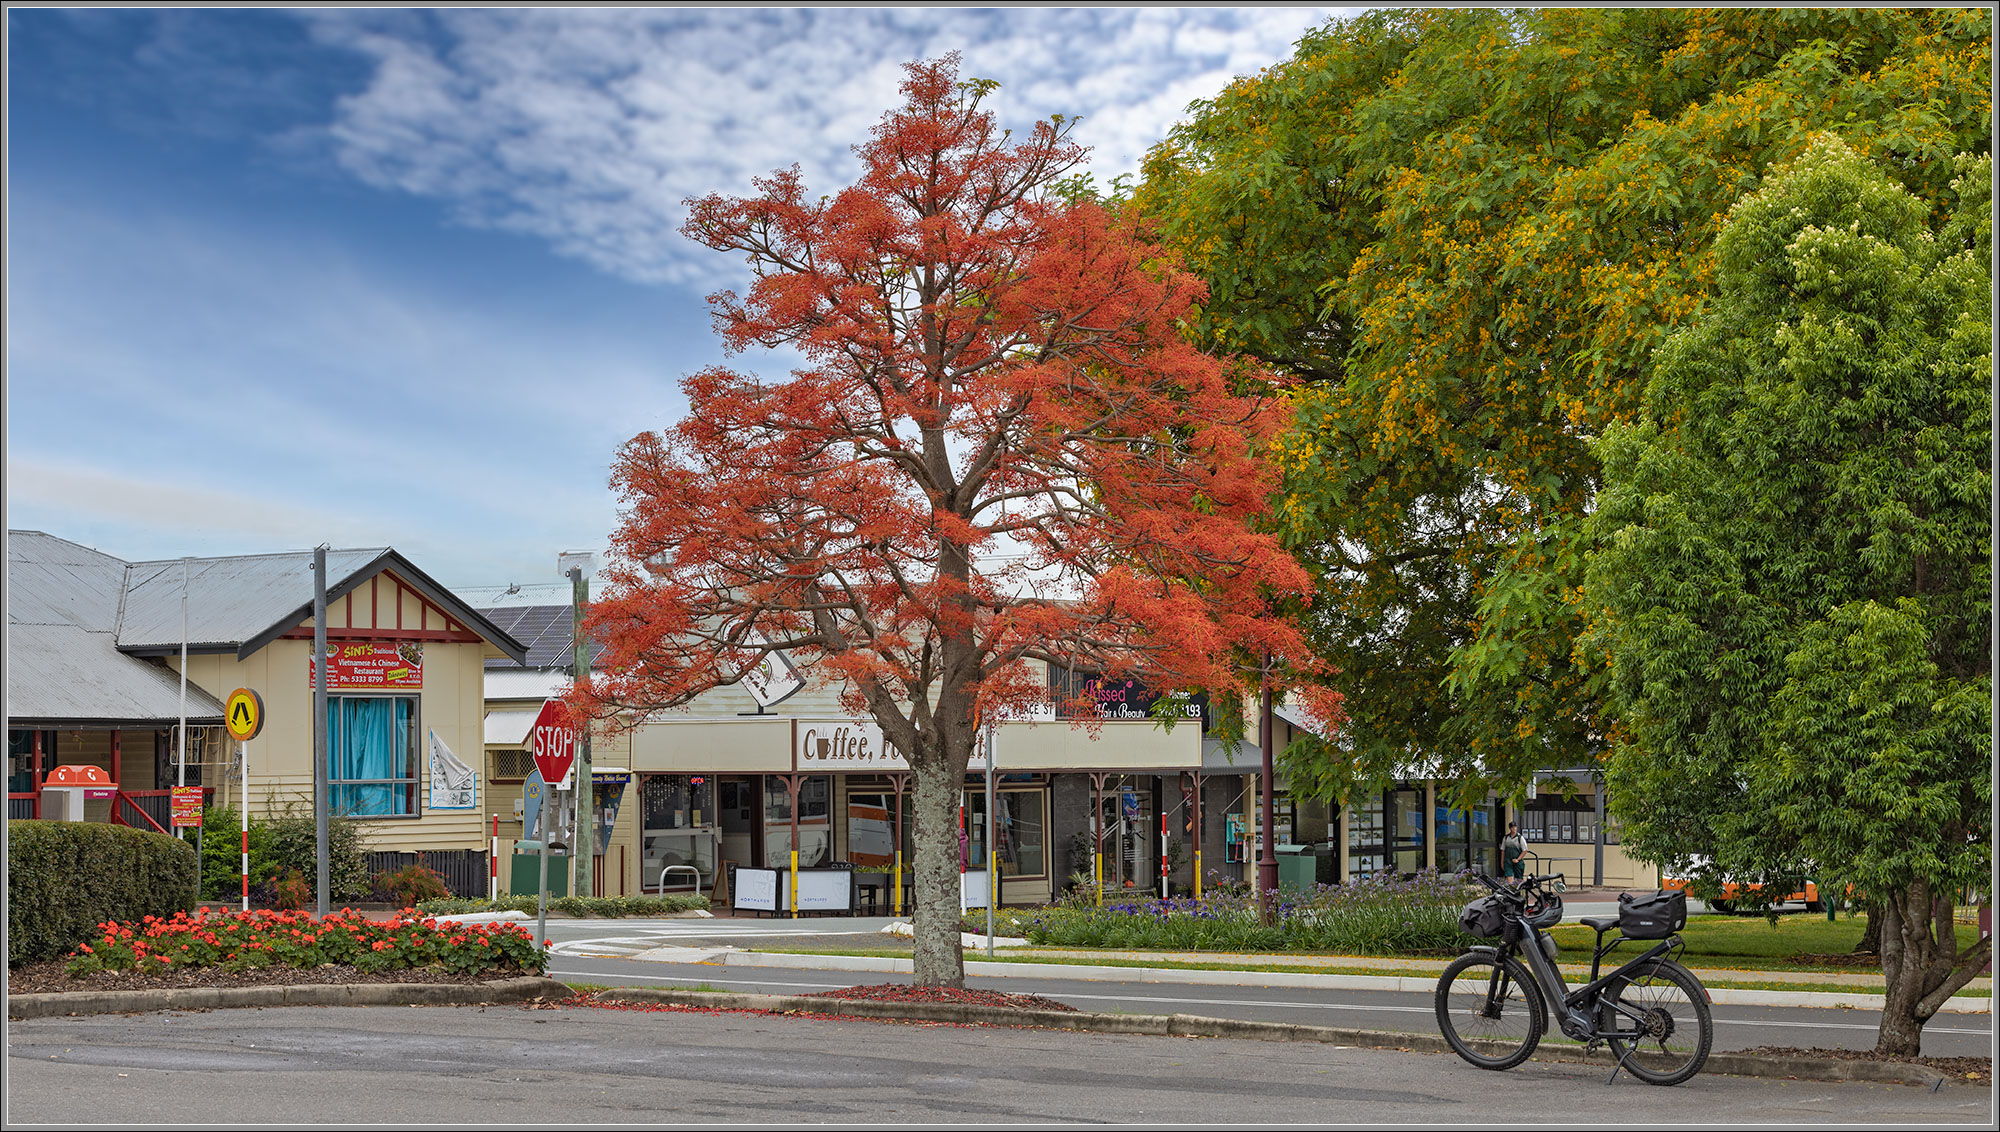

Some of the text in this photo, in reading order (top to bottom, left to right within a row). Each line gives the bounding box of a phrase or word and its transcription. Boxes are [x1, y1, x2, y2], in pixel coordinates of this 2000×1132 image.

[1043, 704, 1053, 714] ST
[1118, 703, 1146, 718] Beauty
[536, 725, 573, 757] STOP
